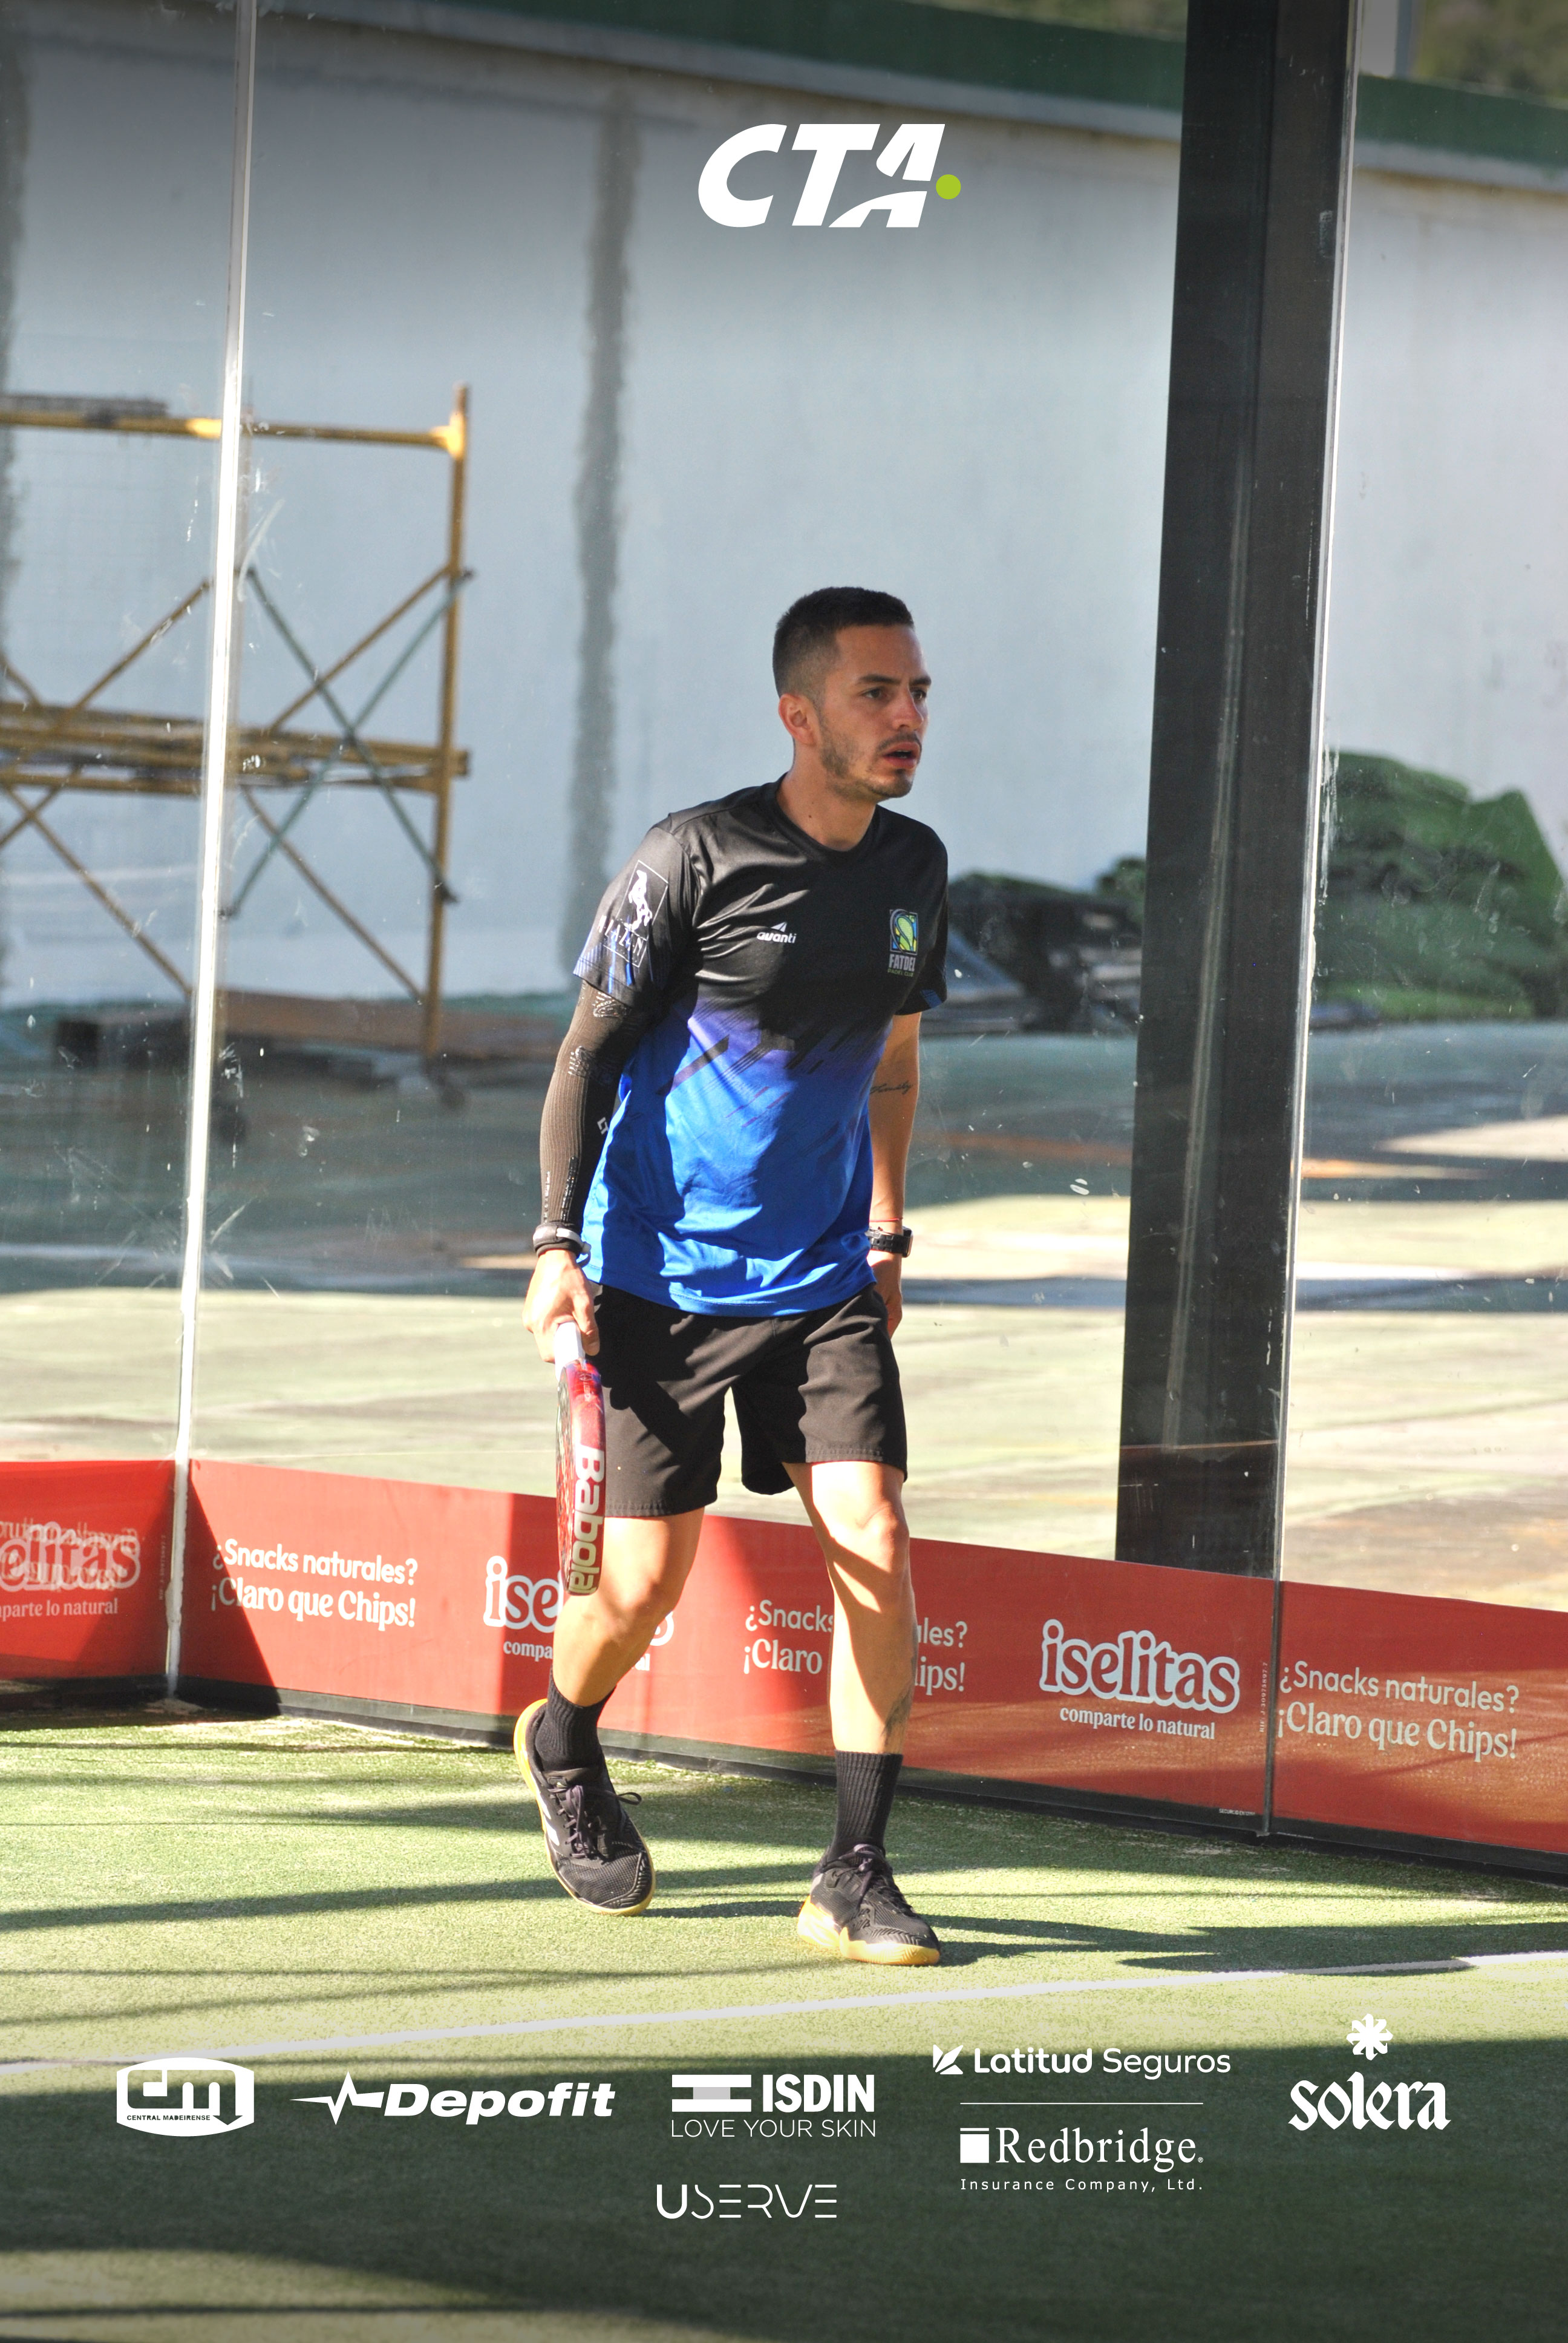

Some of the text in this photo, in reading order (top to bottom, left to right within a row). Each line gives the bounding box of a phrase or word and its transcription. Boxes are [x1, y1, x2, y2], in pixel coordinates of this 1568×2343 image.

[0, 1521, 141, 1592] elitas
[212, 1538, 418, 1585] ¿Snacks naturales?
[46, 1599, 60, 1616] lo
[63, 1598, 119, 1616] natural
[211, 1577, 416, 1631] ¡Claro que Chips!
[503, 1640, 553, 1662] compa
[743, 1638, 965, 1696] ¡Claro ips!
[1039, 1619, 1240, 1714] iselitas
[1280, 1660, 1519, 1714] ¿Snacks naturales?
[1060, 1707, 1215, 1740] comparte lo natural
[1278, 1701, 1517, 1763] ¡Claro que Chips!
